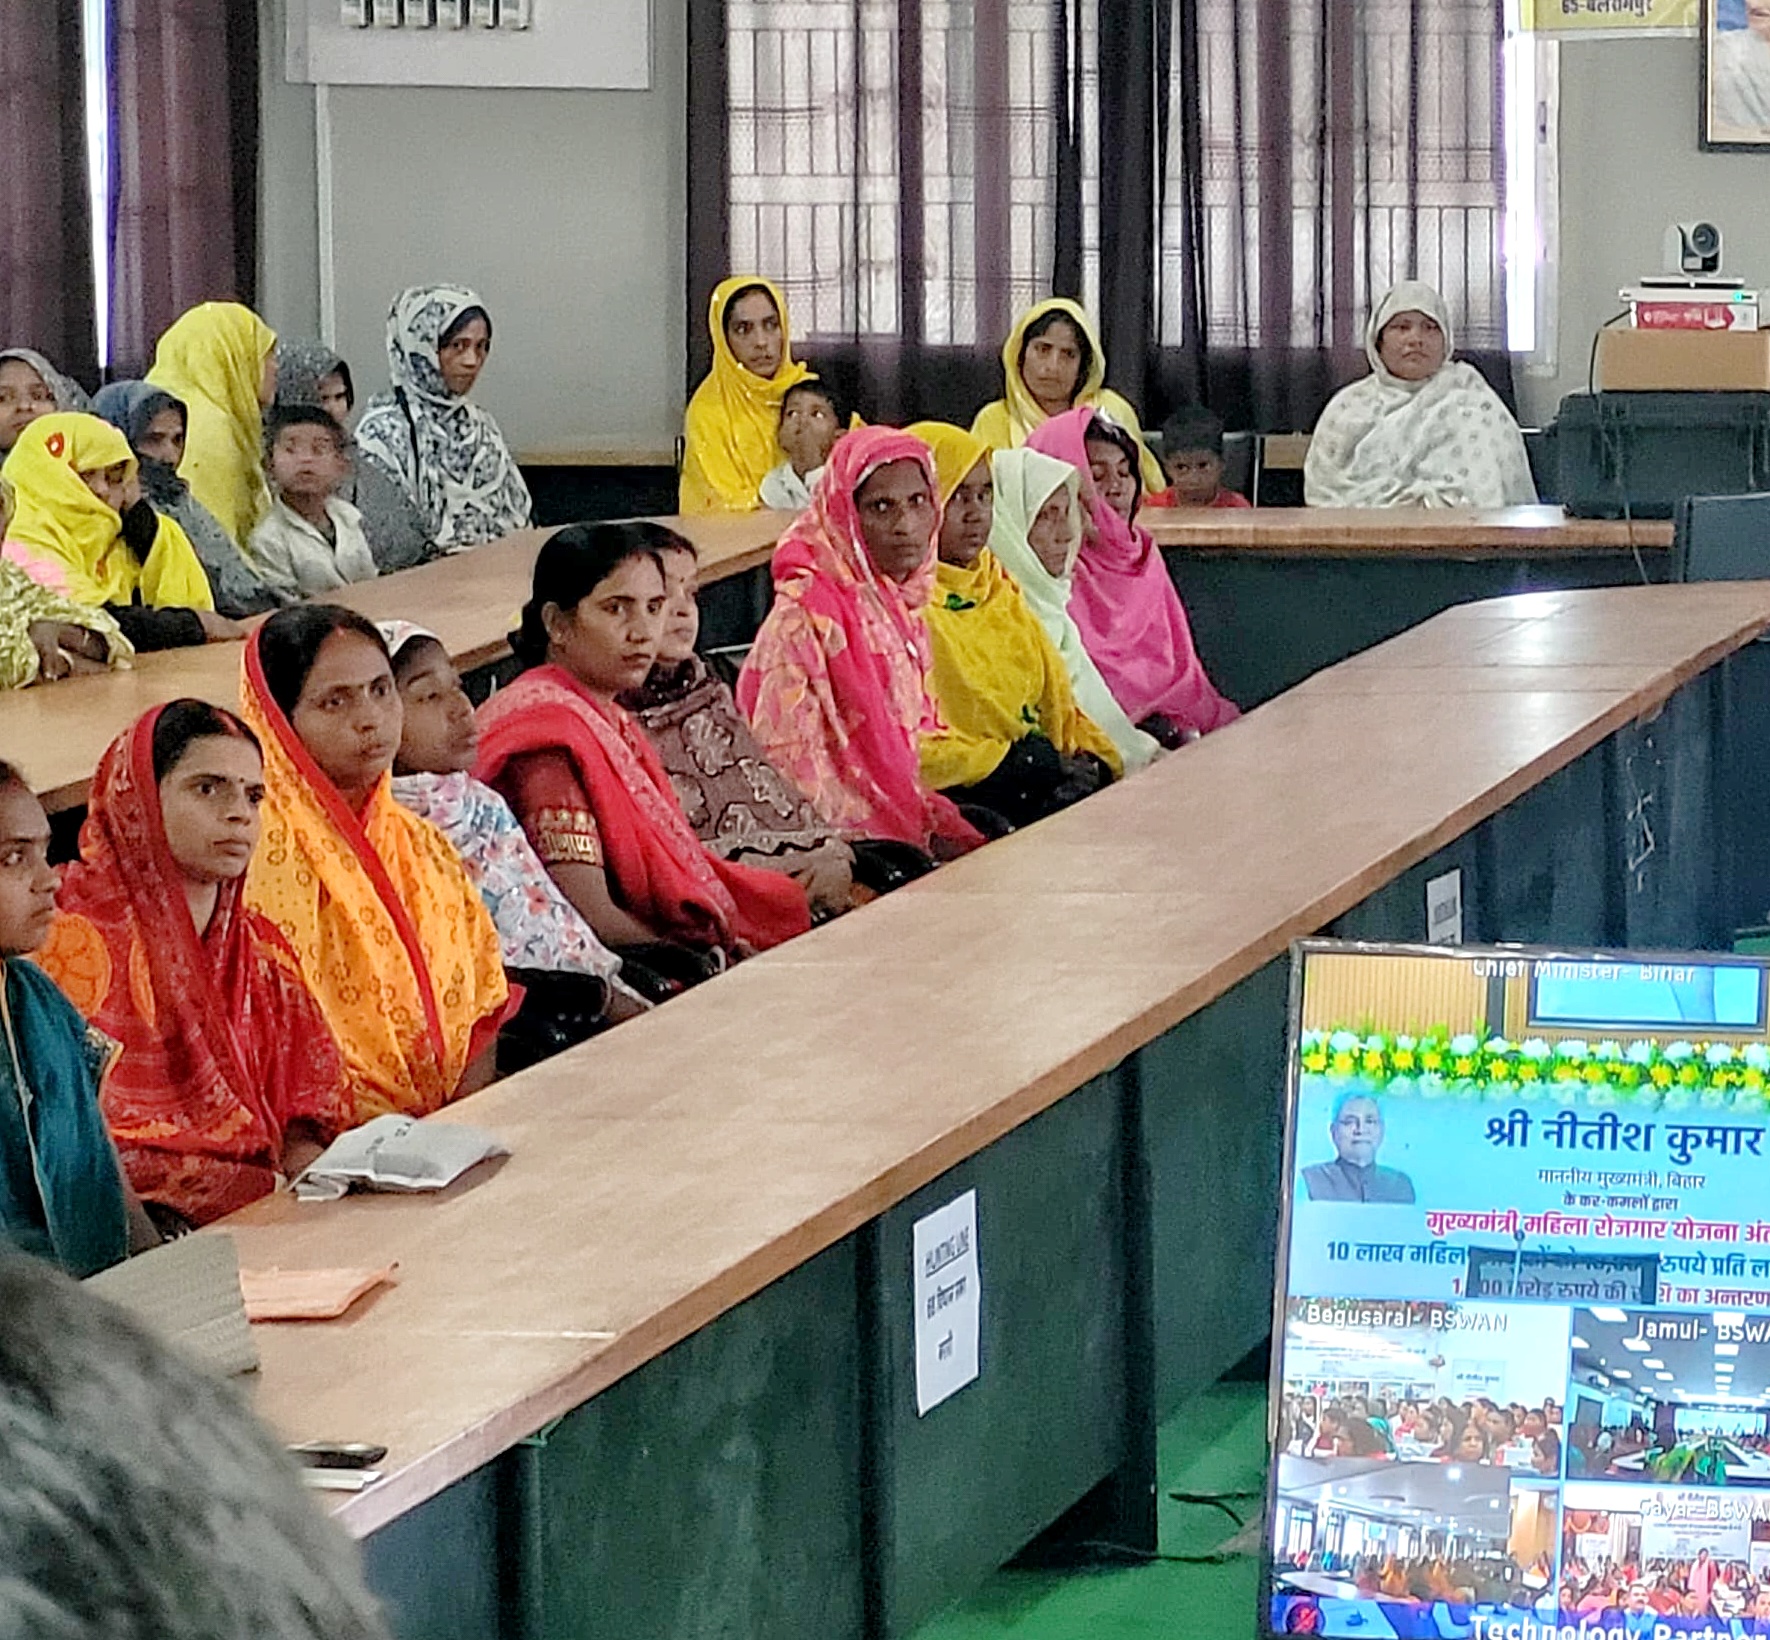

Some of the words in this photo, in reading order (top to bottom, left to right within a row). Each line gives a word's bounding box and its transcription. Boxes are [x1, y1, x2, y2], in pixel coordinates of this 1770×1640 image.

[1484, 1109, 1533, 1148] श्री
[1542, 1111, 1656, 1152] नीतीश
[1665, 1124, 1766, 1165] कुमार
[1538, 1167, 1592, 1184] माननीय
[1563, 1190, 1576, 1207] के
[1426, 1209, 1520, 1237] मुख्यमंत्री
[1523, 1211, 1589, 1237] महिला
[1595, 1213, 1668, 1240] रोजगार
[1673, 1217, 1739, 1242] योजना
[1327, 1241, 1349, 1261] 10
[1355, 1243, 1405, 1263] लाख
[1410, 1241, 1465, 1266] महिल
[1660, 1251, 1706, 1276] रुपये
[1710, 1253, 1747, 1278] प्रति
[1676, 1286, 1700, 1304] का
